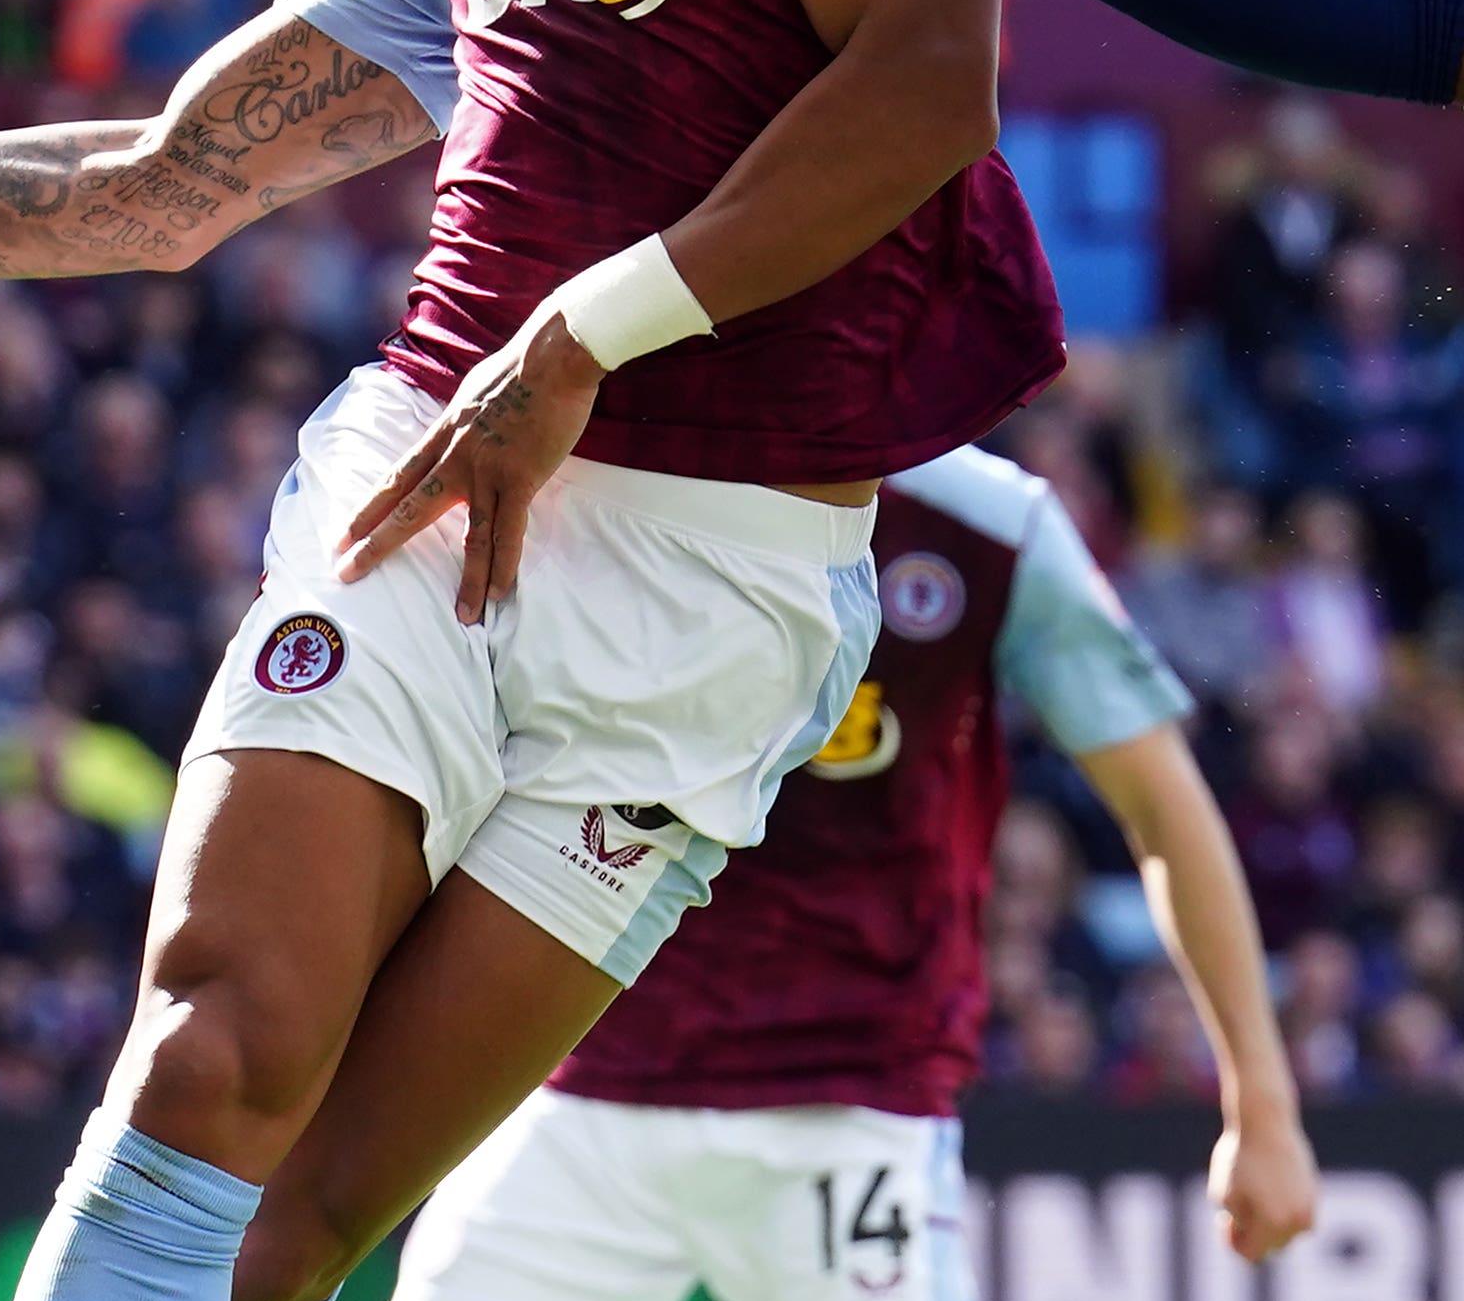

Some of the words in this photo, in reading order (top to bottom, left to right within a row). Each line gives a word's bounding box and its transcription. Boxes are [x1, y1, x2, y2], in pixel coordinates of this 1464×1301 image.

[276, 618, 313, 642] ASTON
[316, 620, 340, 651] VILLA
[559, 844, 625, 893] CASTORE
[815, 1166, 910, 1273] 14
